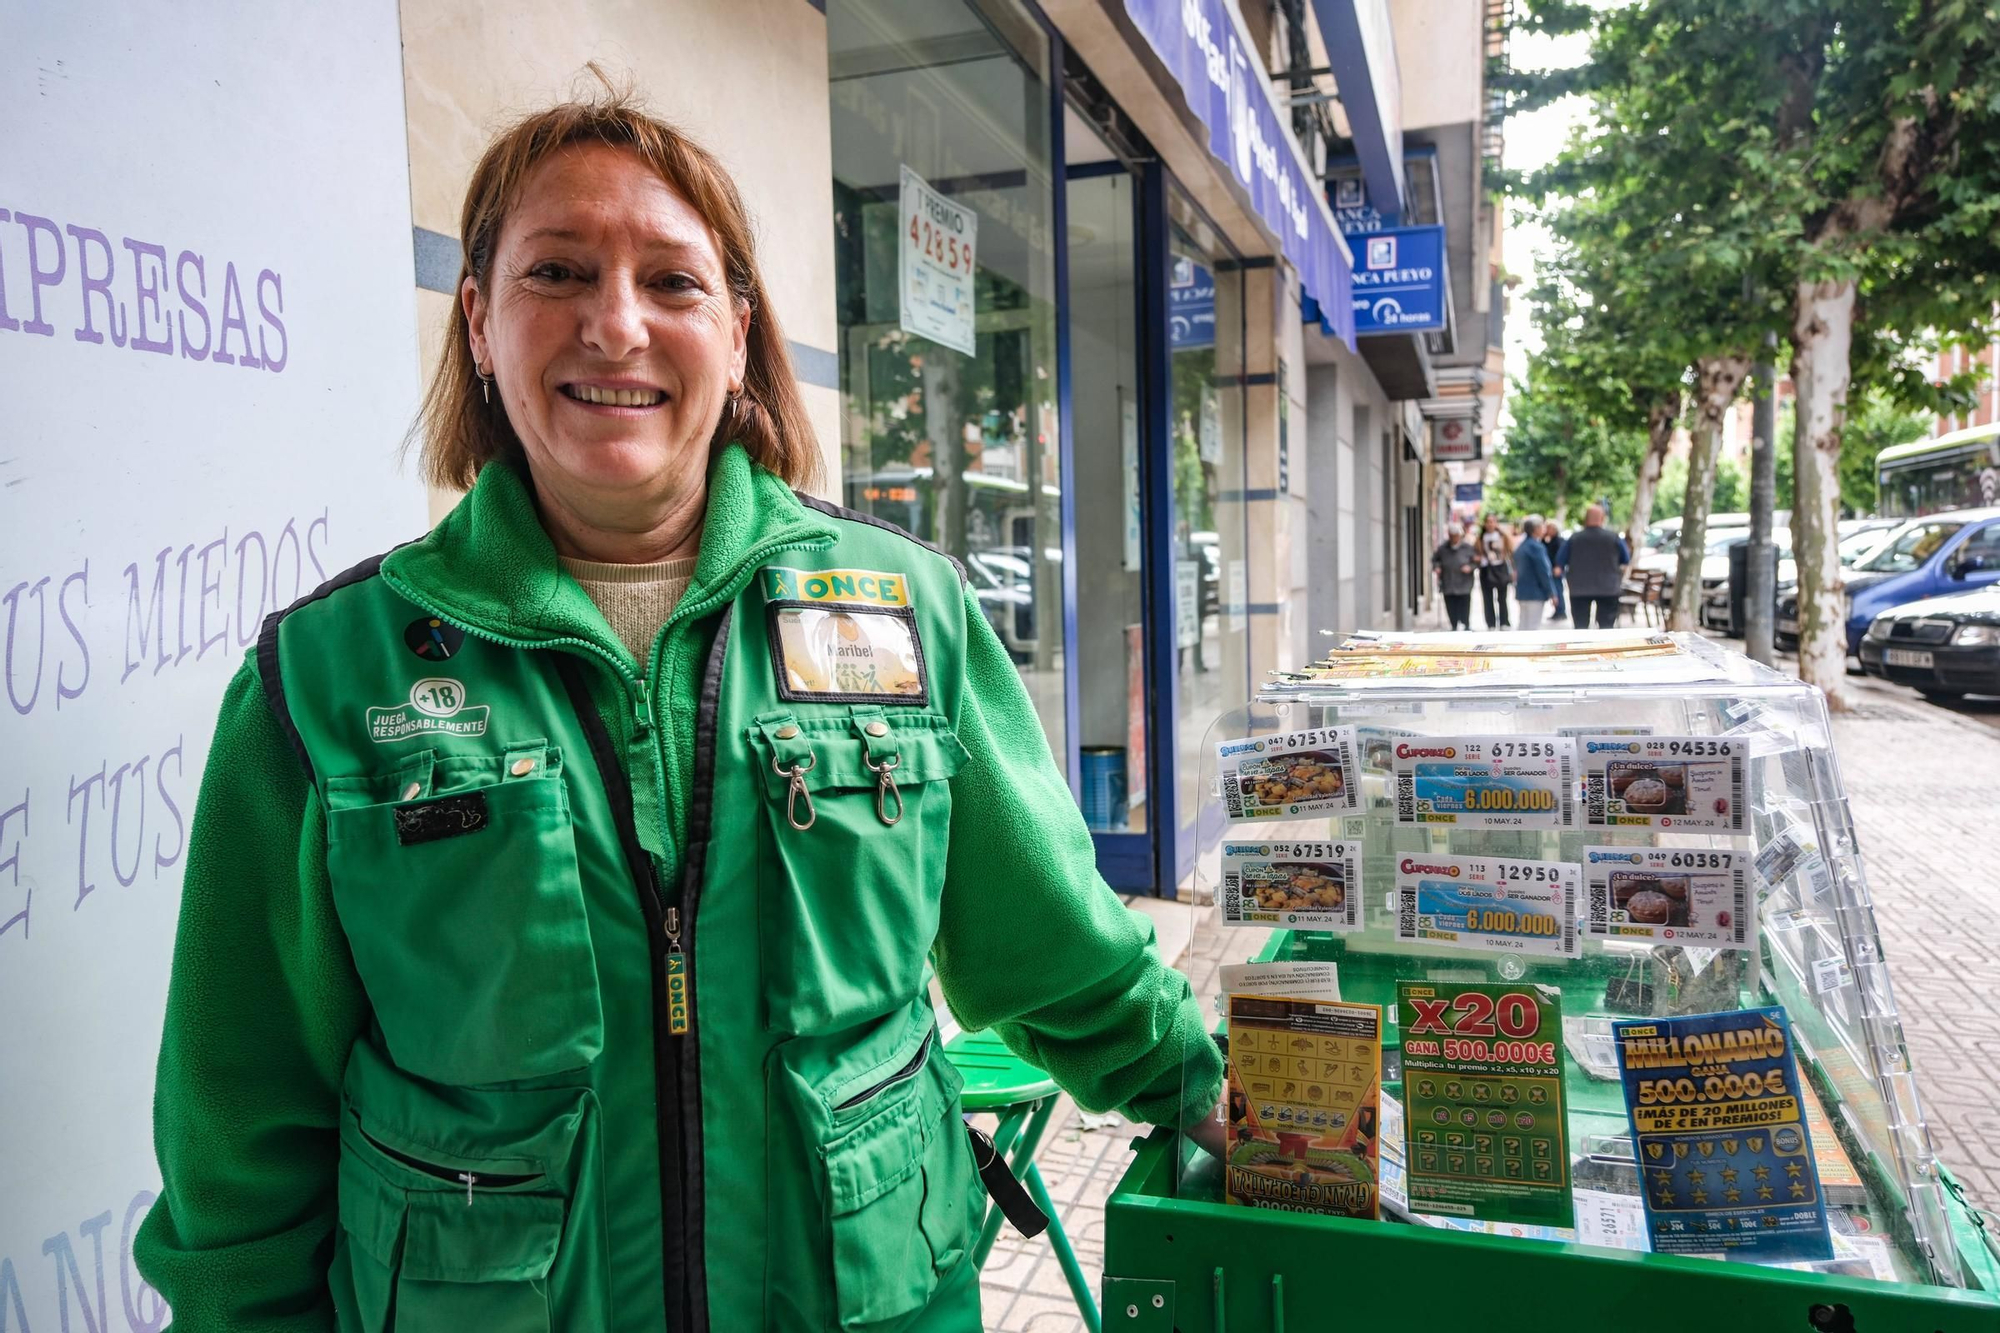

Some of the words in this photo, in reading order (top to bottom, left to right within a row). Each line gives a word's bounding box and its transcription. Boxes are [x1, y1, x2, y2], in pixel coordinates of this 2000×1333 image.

[925, 193, 964, 235] PREMIO
[1335, 207, 1381, 222] ANCA
[1350, 272, 1380, 286] NCA
[803, 574, 899, 602] ONCE
[419, 686, 456, 709] +18
[373, 712, 406, 726] JUEGA
[373, 718, 485, 738] RESPONSABLEMENTE
[1268, 737, 1283, 745] 047
[1287, 729, 1338, 747] 67519
[1465, 744, 1480, 752] 122
[1492, 743, 1554, 758] 67358
[1669, 741, 1731, 756] 94536
[1256, 808, 1280, 816] ONCE
[1428, 814, 1454, 822] ONCE
[68, 733, 184, 912] TUS
[1619, 817, 1649, 825] ONCE
[1293, 844, 1344, 858] 67519
[1671, 853, 1732, 868] 60387
[1469, 864, 1485, 873] 113
[1498, 864, 1560, 882] 12950
[1520, 894, 1551, 902] GANADOR
[1429, 931, 1456, 941] ONCE
[1622, 927, 1651, 935] ONCE
[670, 976, 686, 1030] ONCE
[1770, 1011, 1781, 1020] 5€
[1405, 1040, 1440, 1056] GANA
[1443, 1039, 1556, 1065] 500.000€
[1625, 1027, 1785, 1070] MILLONARIO
[1405, 1060, 1444, 1069] Multiplica
[1459, 1064, 1488, 1072] premio
[1506, 1066, 1518, 1074] x5,
[1543, 1067, 1560, 1075] x20
[1691, 1064, 1730, 1077] GANA
[1638, 1069, 1786, 1104] 500.000€
[1637, 1106, 1675, 1119] ¡MÁS
[1680, 1108, 1698, 1118] DE
[1703, 1105, 1721, 1116] 20
[1726, 1099, 1793, 1115] MILLONES
[1654, 1118, 1672, 1129] DE
[1676, 1118, 1686, 1128] €
[1690, 1117, 1707, 1127] EN
[1713, 1110, 1781, 1125] PREMIOS!
[1775, 1136, 1799, 1145] BONUS
[1231, 1166, 1322, 1204] CLEOPATRA
[1323, 1181, 1371, 1210] GRAN
[1794, 1211, 1817, 1220] DOBLE
